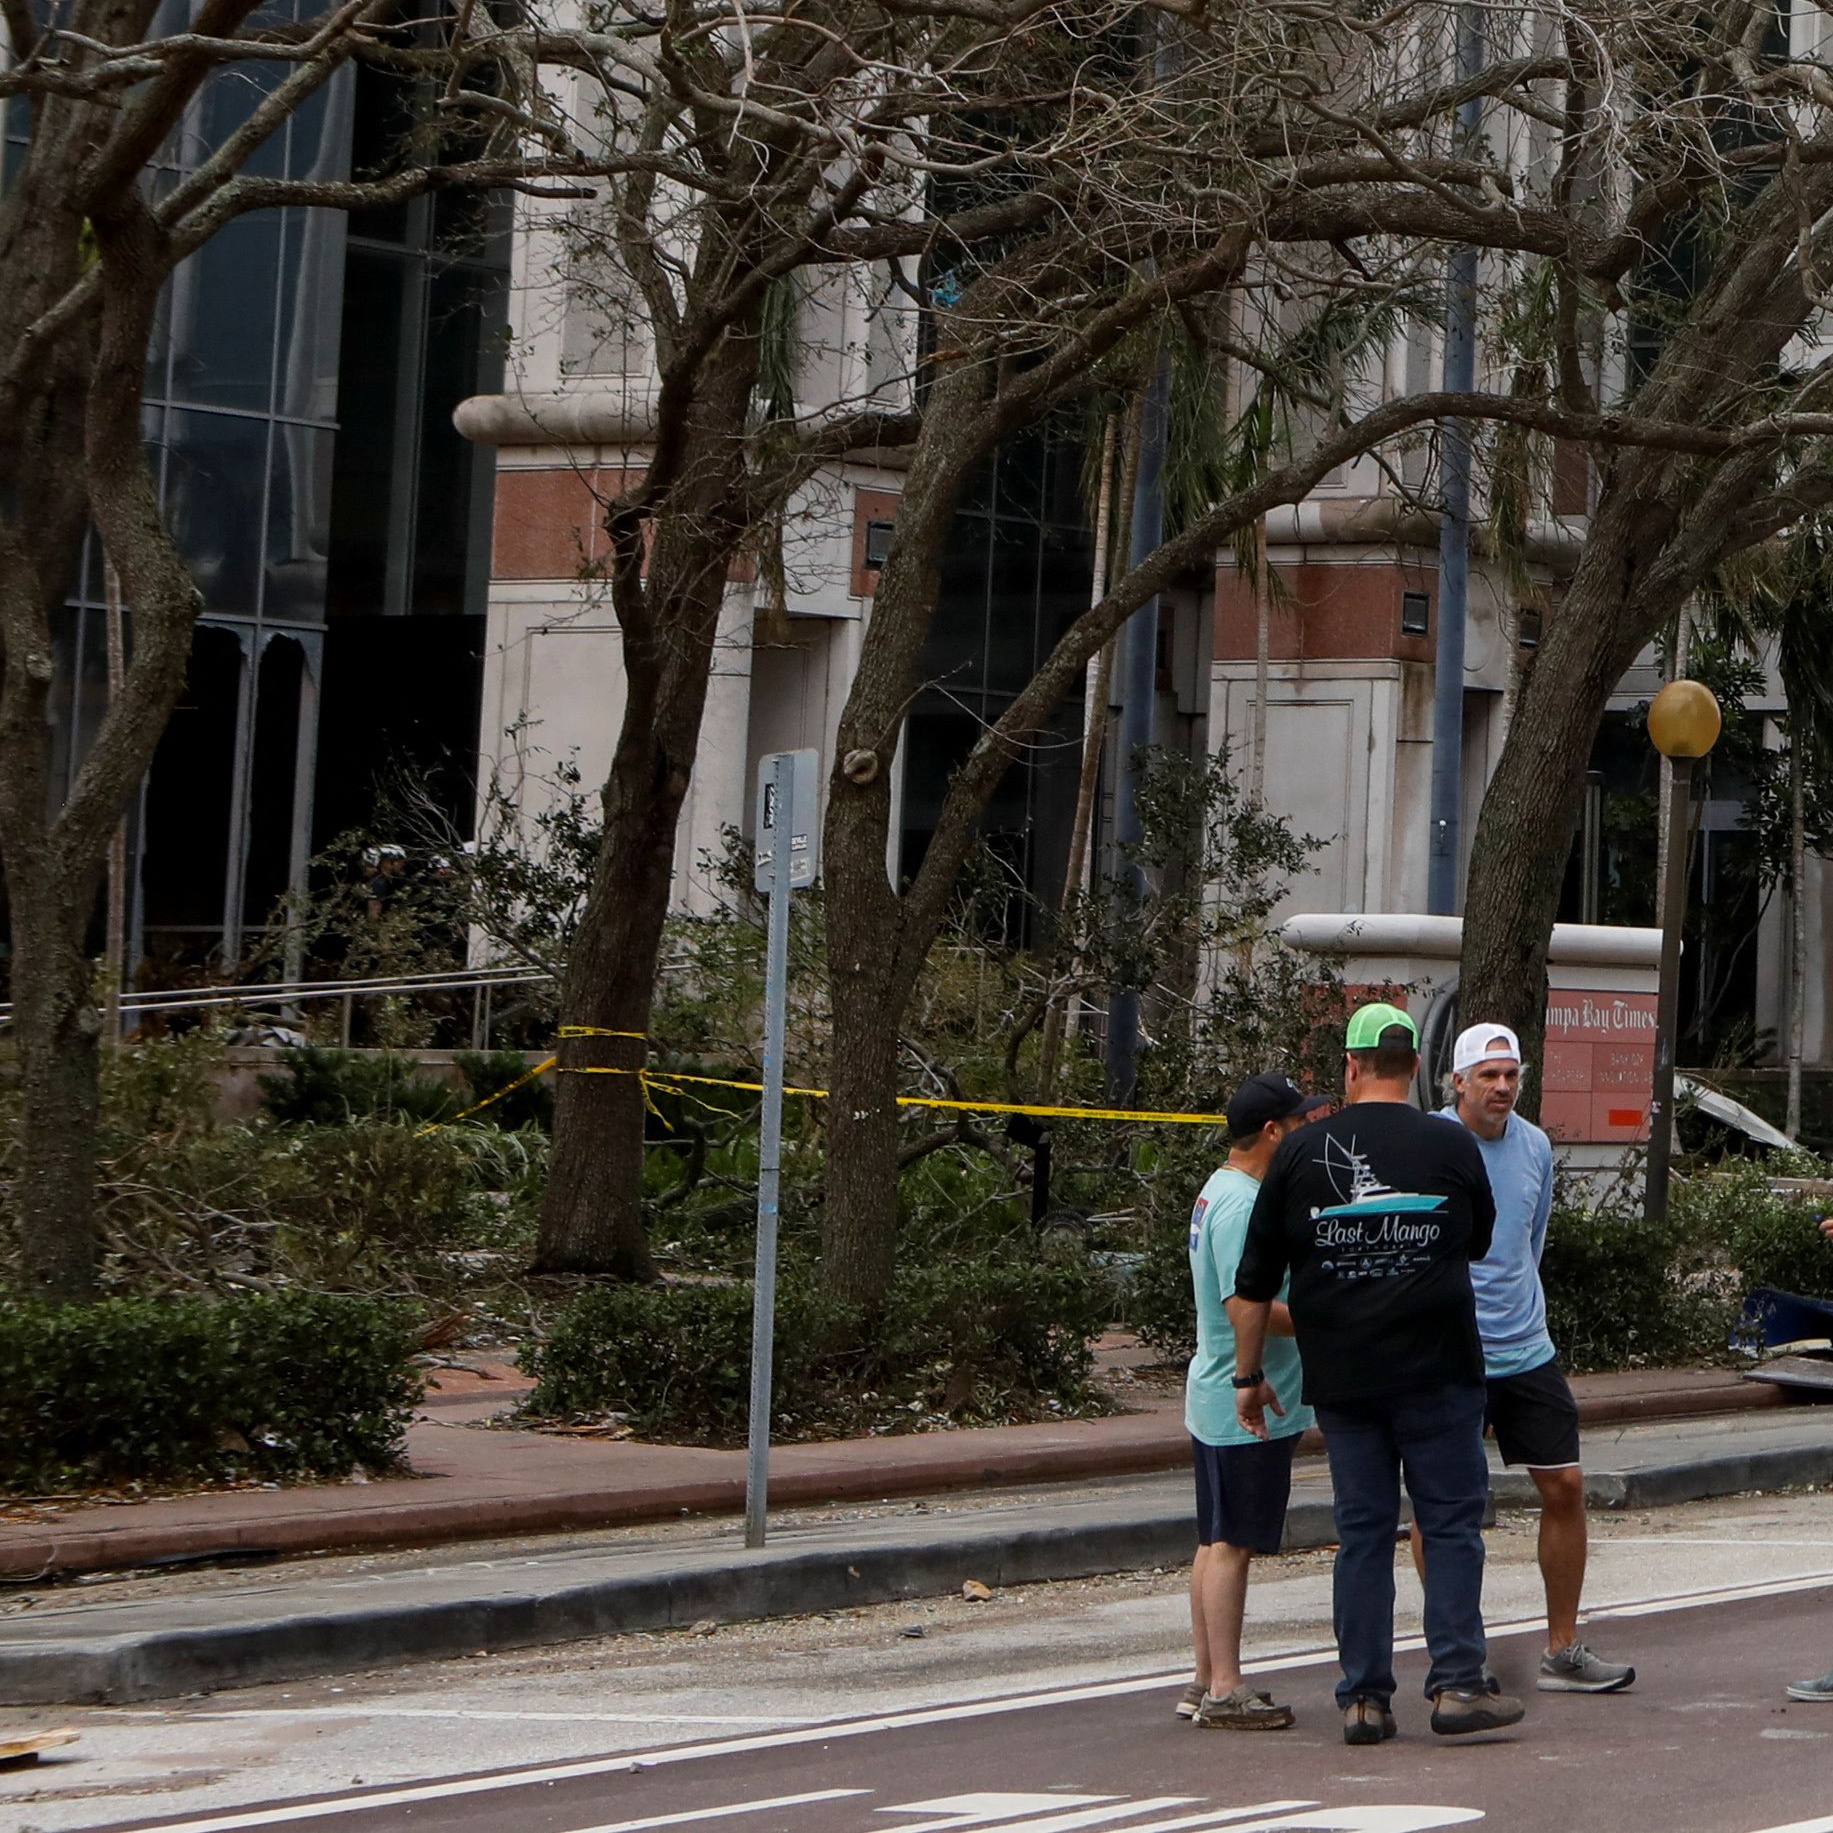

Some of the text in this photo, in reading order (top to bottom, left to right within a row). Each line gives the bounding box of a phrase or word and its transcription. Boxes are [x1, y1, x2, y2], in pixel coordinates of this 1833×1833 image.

[1546, 1005, 1579, 1034] mpa
[1582, 998, 1610, 1034] Bay
[1315, 1215, 1440, 1247] Last Mango
